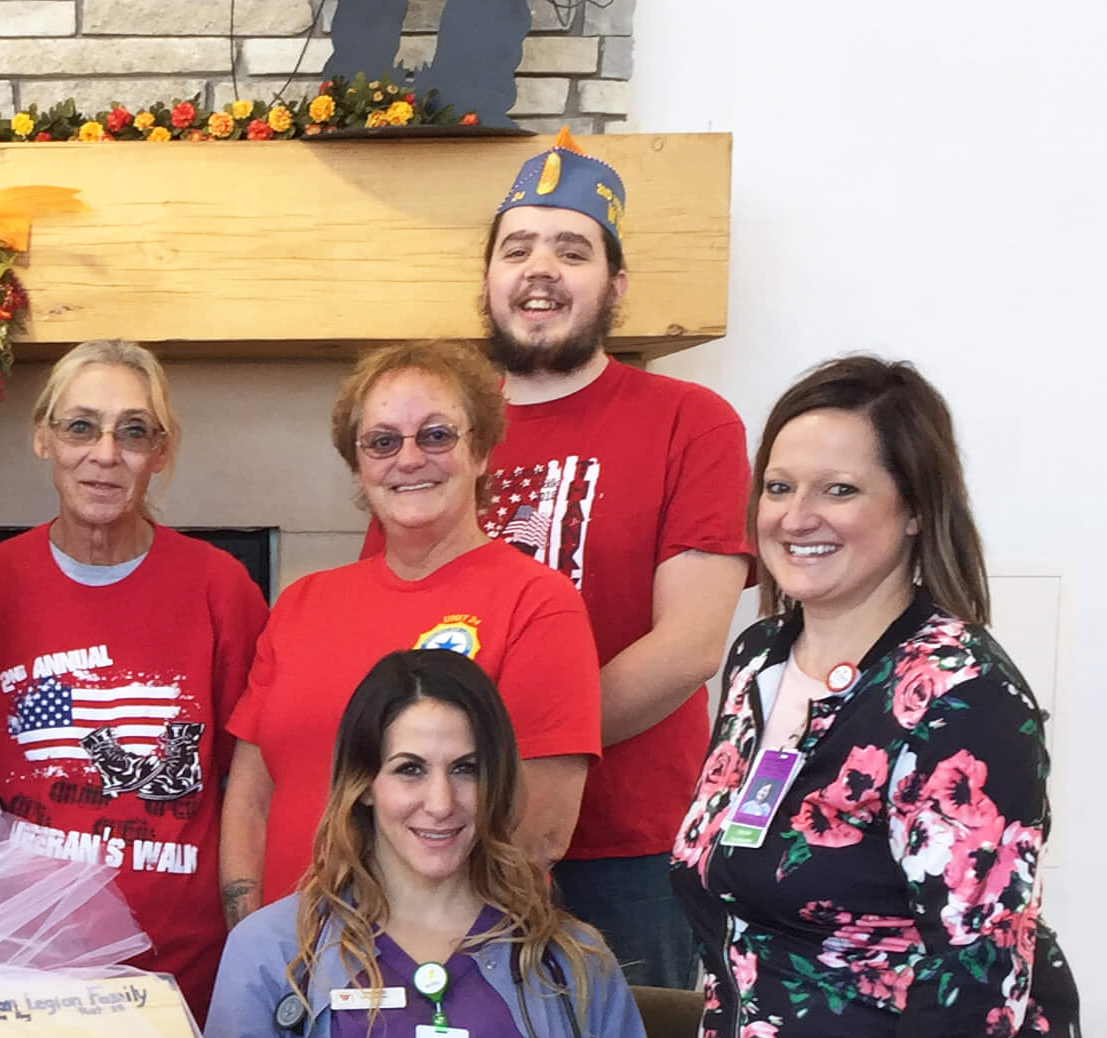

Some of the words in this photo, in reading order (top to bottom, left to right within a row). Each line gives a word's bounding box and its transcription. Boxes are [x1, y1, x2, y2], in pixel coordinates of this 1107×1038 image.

[0, 664, 27, 694] 2ND
[32, 644, 113, 680] ANNUAL
[133, 840, 198, 874] WALK
[25, 990, 83, 1016] Legion
[88, 984, 147, 1008] Family
